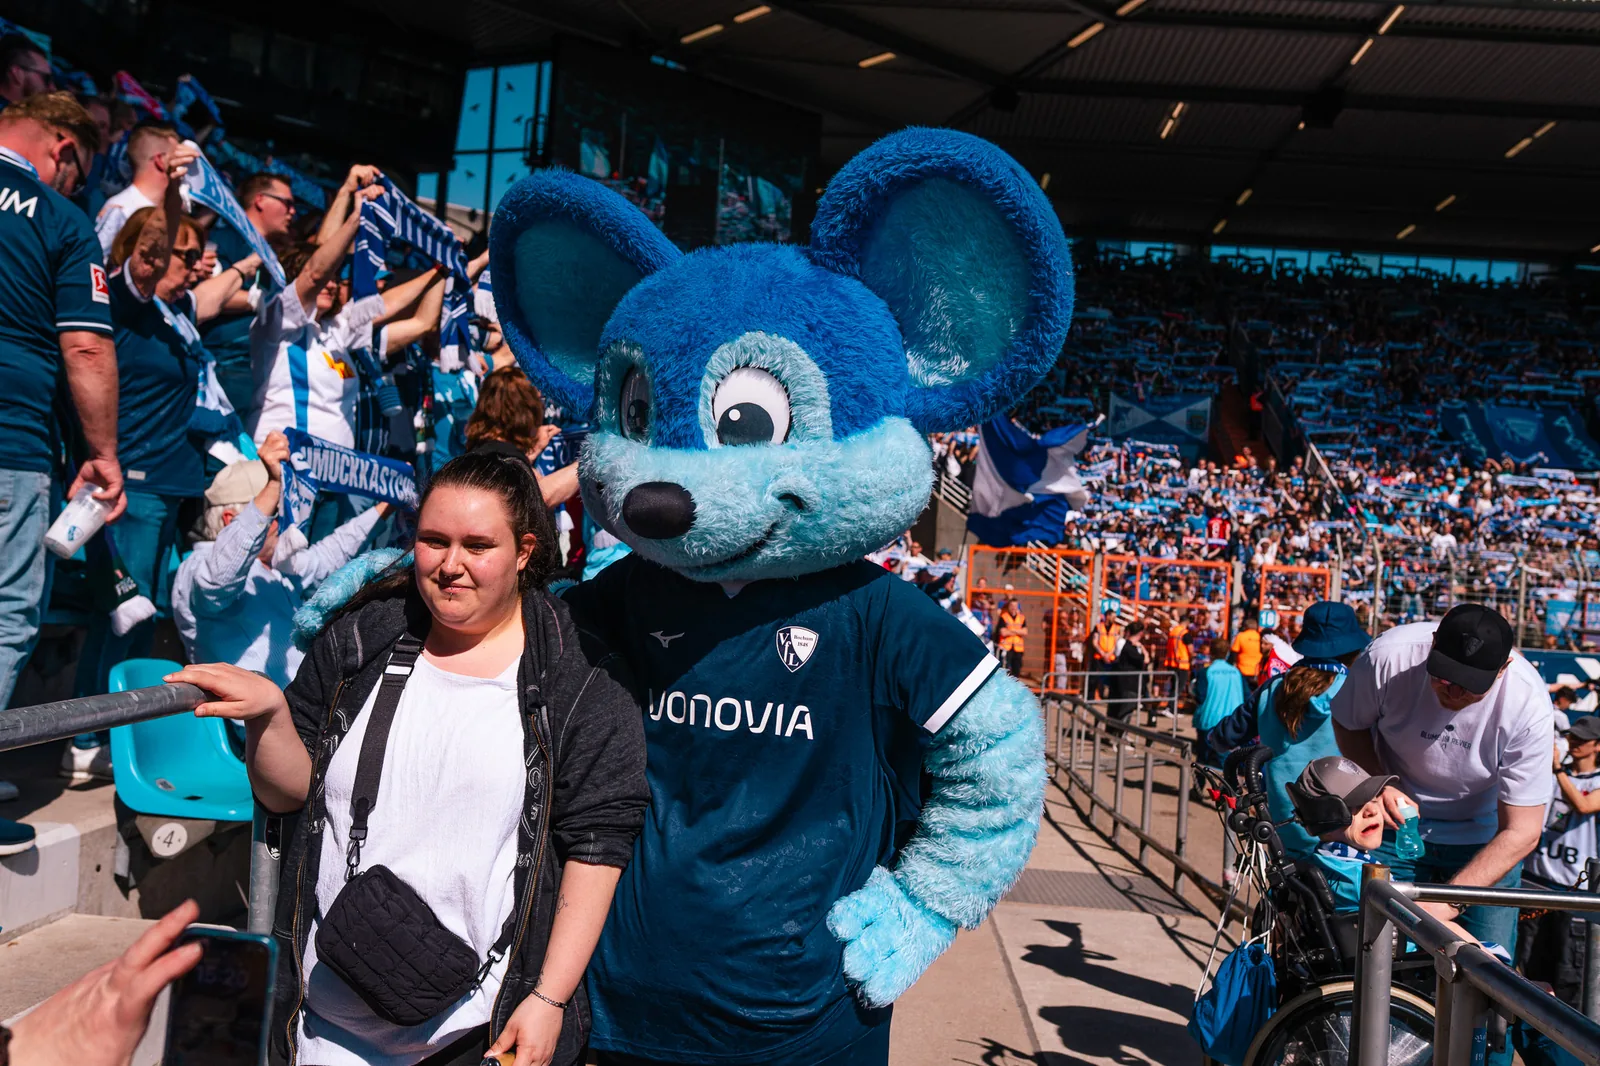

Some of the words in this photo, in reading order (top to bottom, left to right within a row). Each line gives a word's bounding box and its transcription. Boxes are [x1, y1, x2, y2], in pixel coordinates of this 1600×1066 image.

[794, 634, 814, 642] Bochum
[779, 632, 799, 666] VfL
[162, 829, 176, 848] 4
